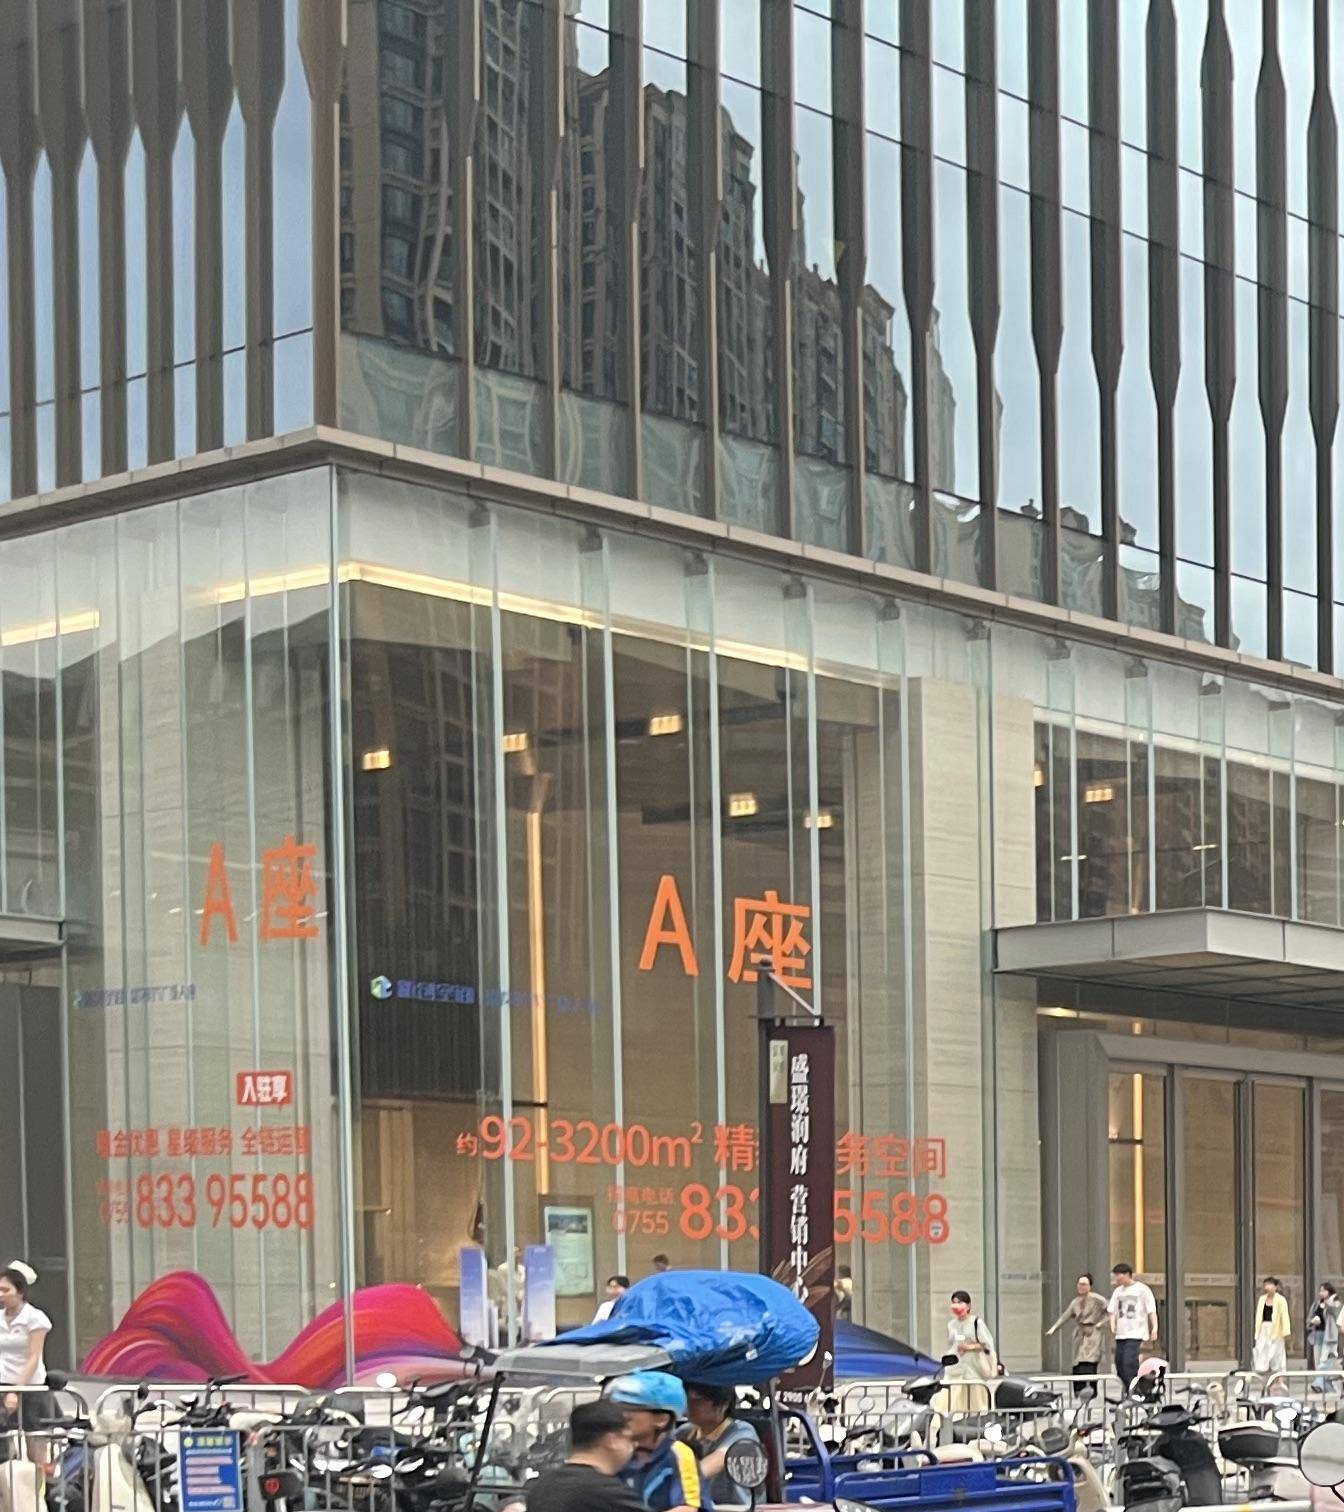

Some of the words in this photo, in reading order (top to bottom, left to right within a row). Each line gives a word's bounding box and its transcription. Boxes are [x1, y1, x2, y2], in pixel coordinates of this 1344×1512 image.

[639, 874, 812, 989] A座
[136, 1172, 197, 1230] 833
[206, 1171, 315, 1230] 95588
[833, 1190, 950, 1245] 5588
